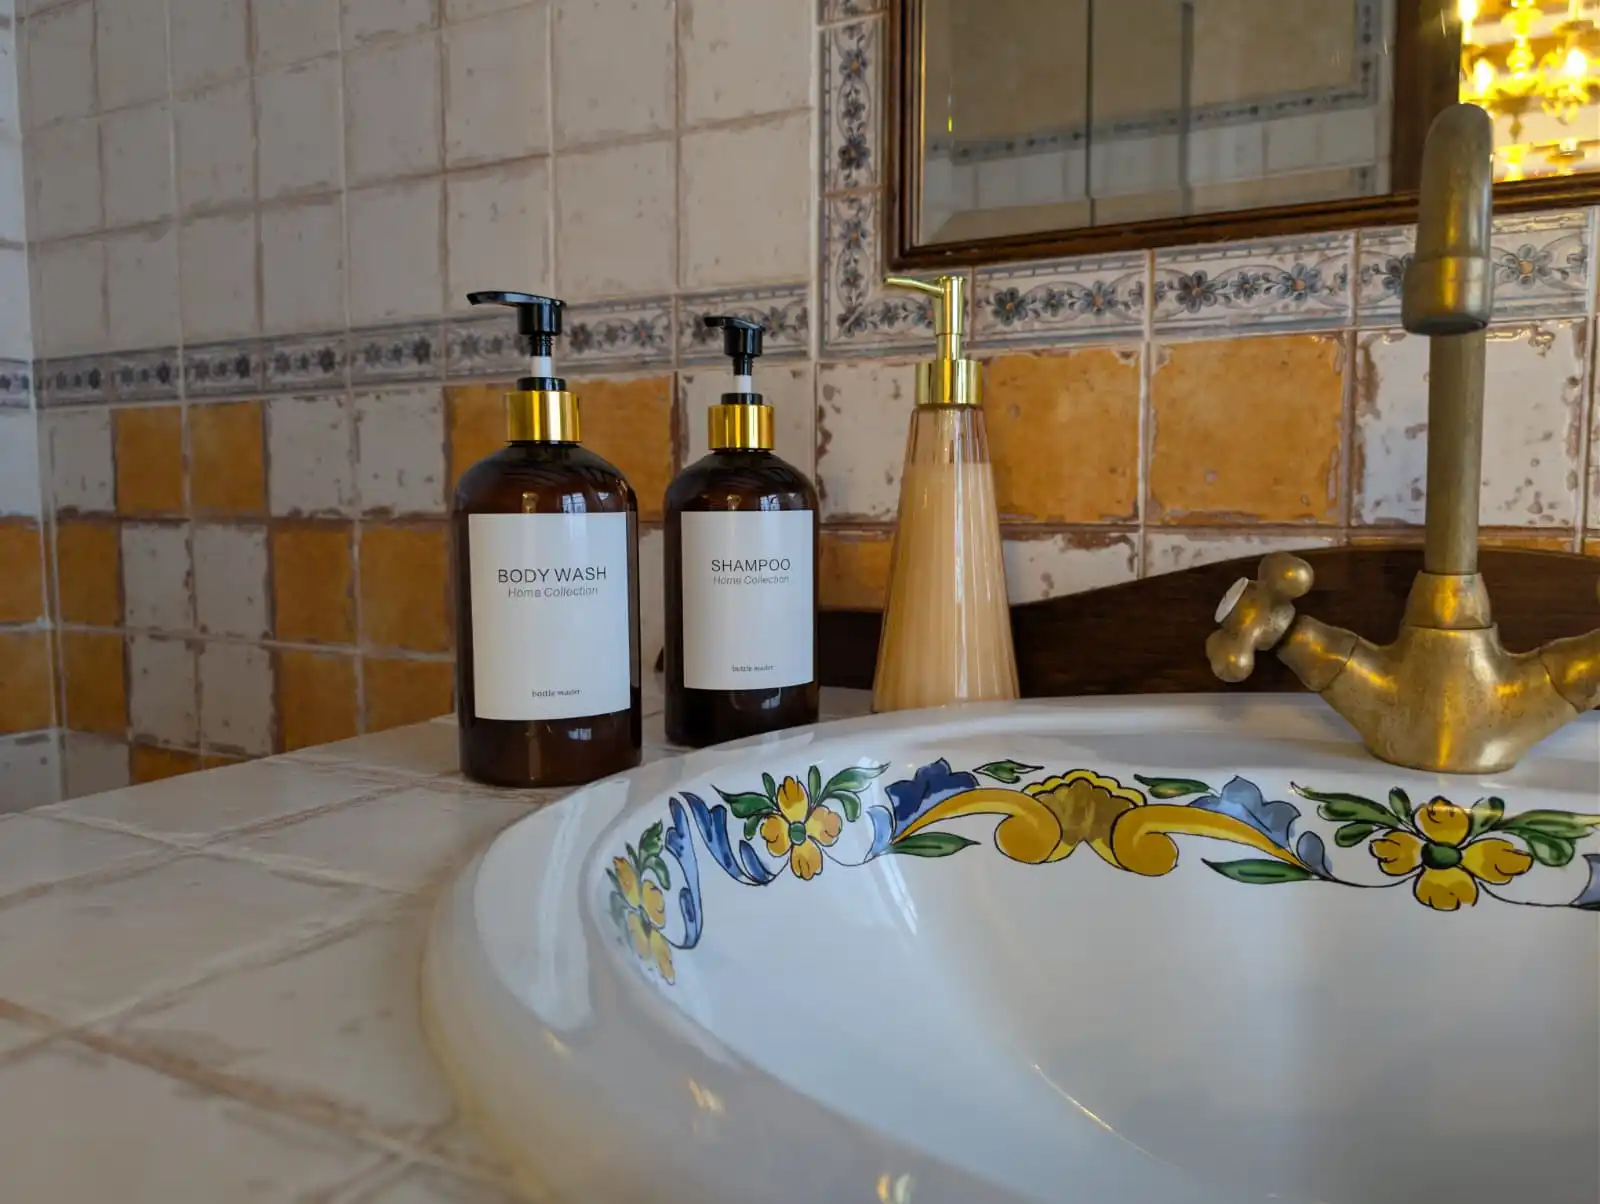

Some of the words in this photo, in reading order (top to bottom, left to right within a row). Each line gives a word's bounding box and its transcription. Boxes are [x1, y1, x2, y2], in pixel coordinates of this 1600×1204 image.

[711, 558, 791, 573] SHAMPOO
[498, 569, 550, 583] BODY
[553, 566, 607, 582] WASH
[713, 576, 742, 586] Home
[743, 575, 790, 585] Collection
[508, 588, 542, 598] Home
[543, 585, 598, 597] Collection
